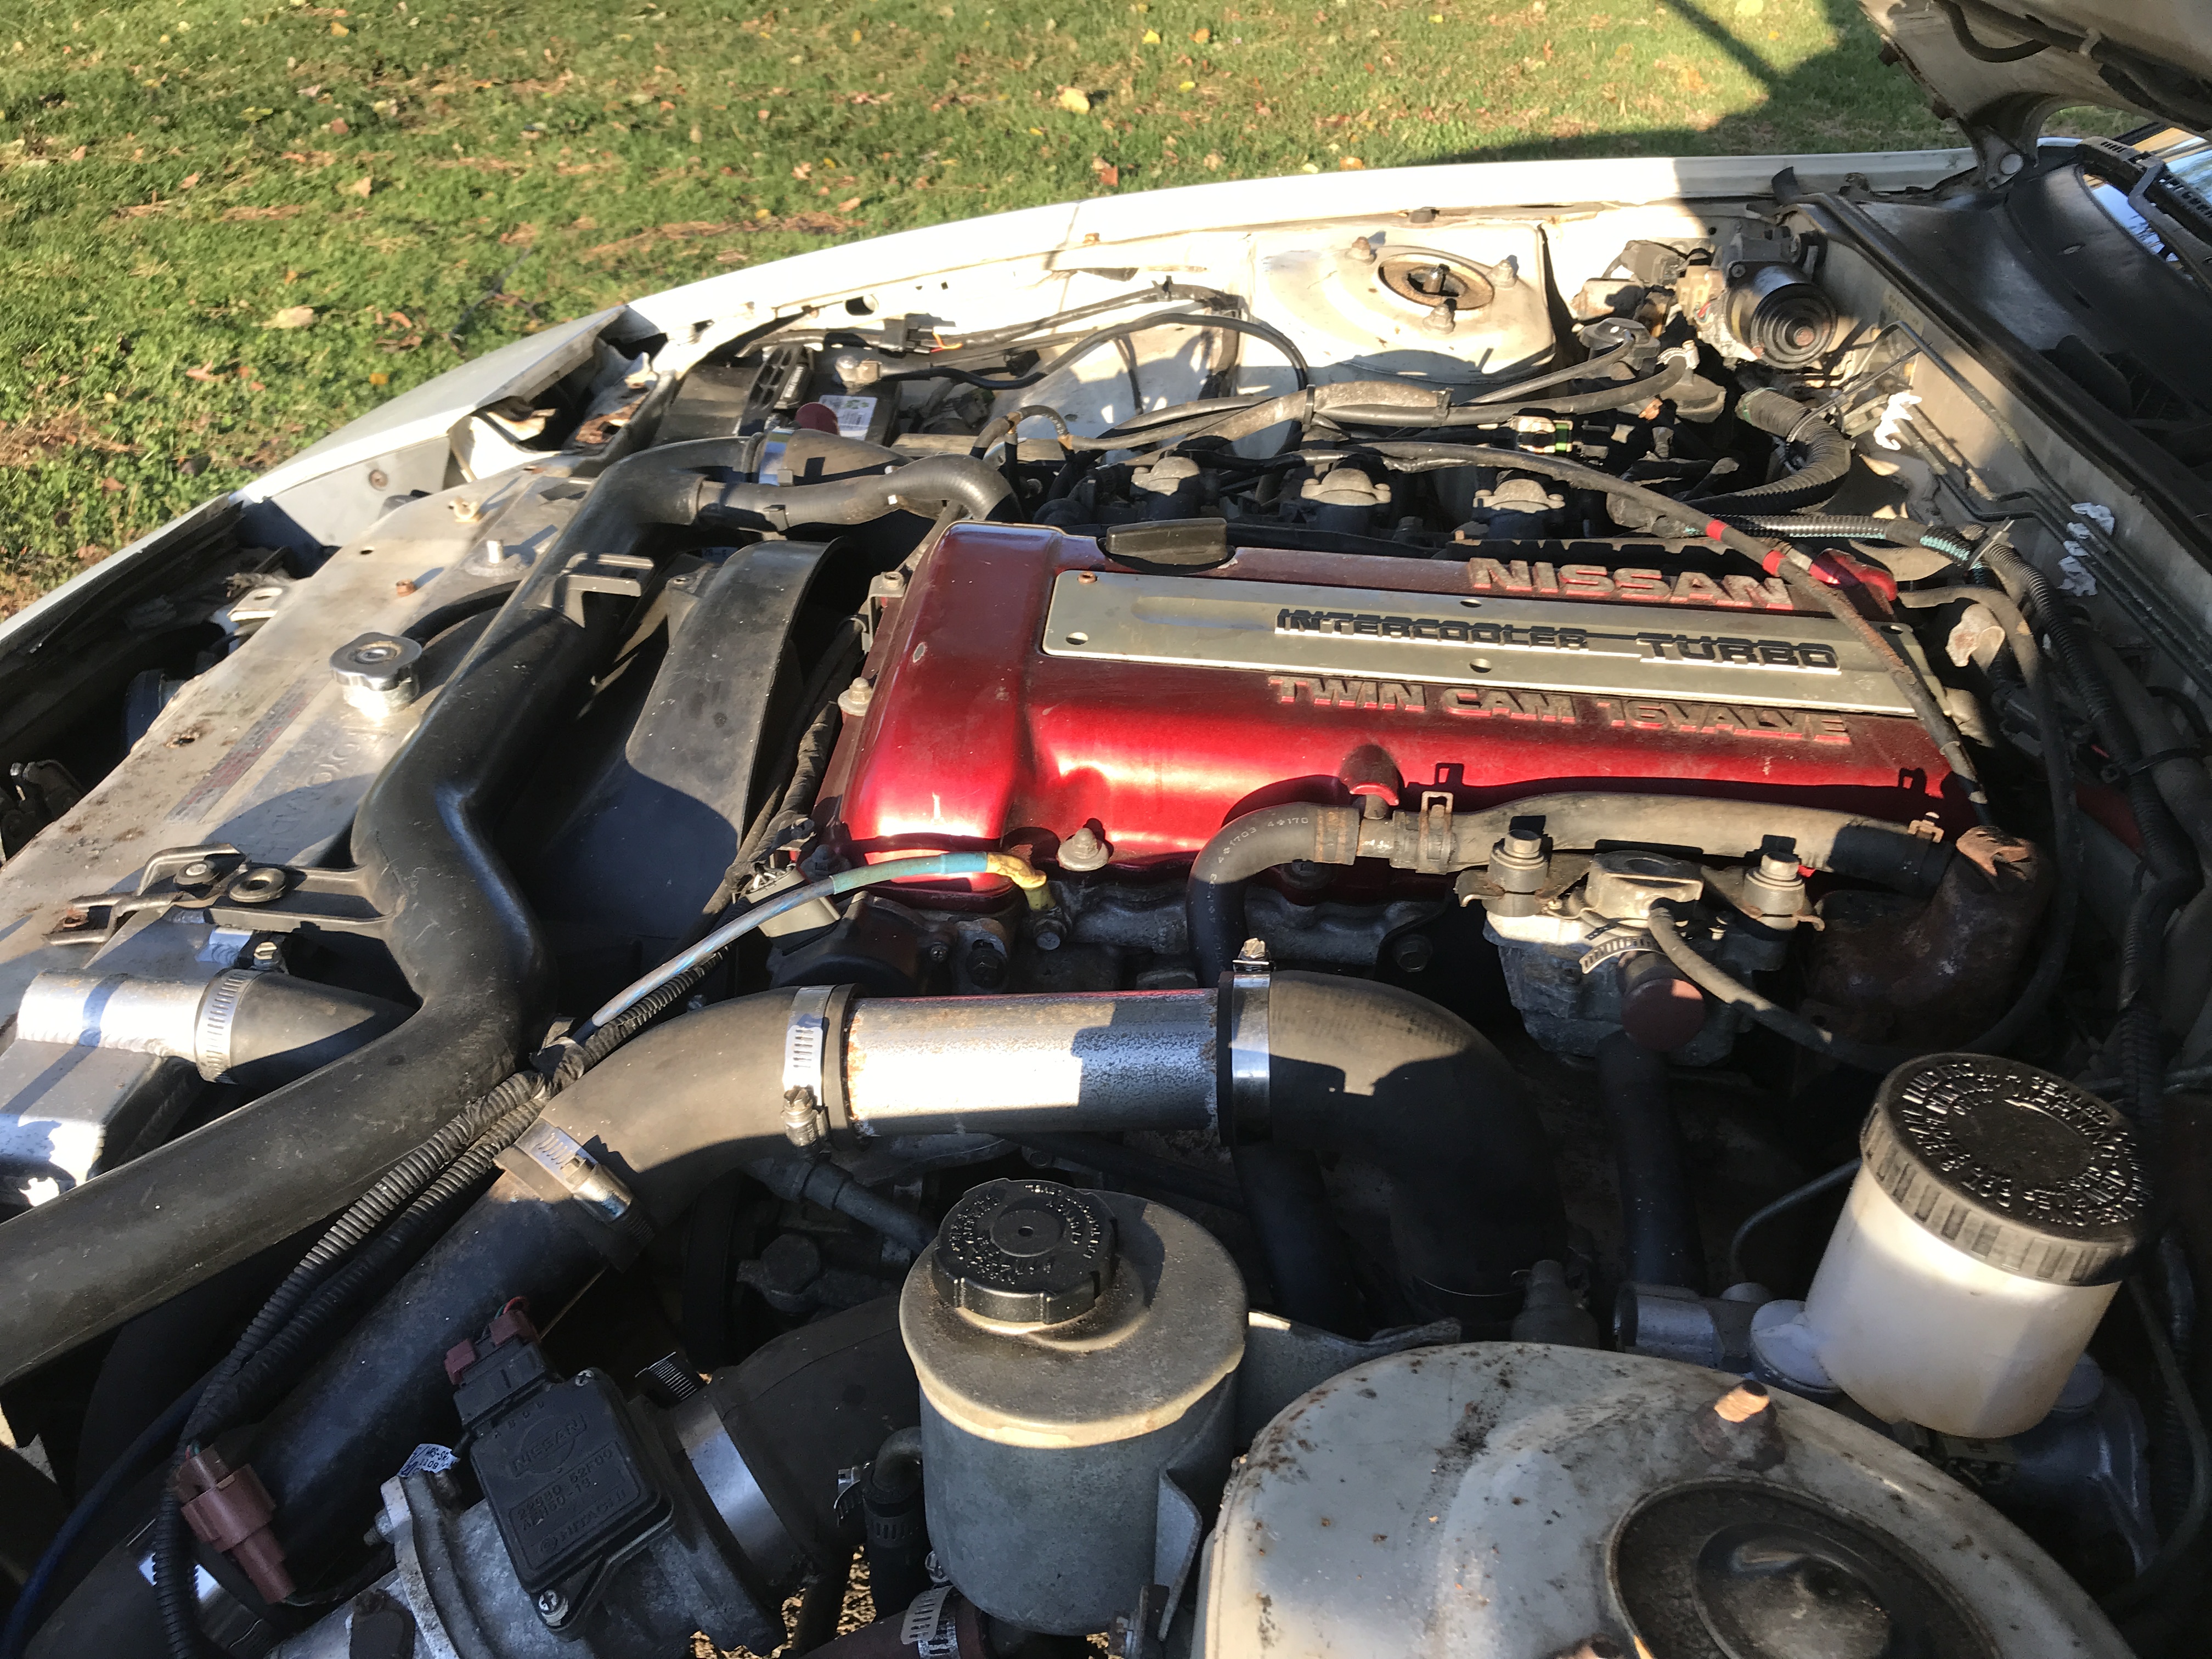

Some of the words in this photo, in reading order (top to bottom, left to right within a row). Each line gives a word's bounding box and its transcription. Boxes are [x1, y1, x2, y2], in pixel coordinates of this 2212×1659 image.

[1467, 557, 1793, 610] NISSAN
[1275, 609, 1589, 651] INTERCOOLER
[1637, 632, 1839, 674] TURBO
[1269, 676, 1425, 712] TWIN
[1443, 686, 1576, 724] CAM
[509, 1419, 582, 1472] NISSAN
